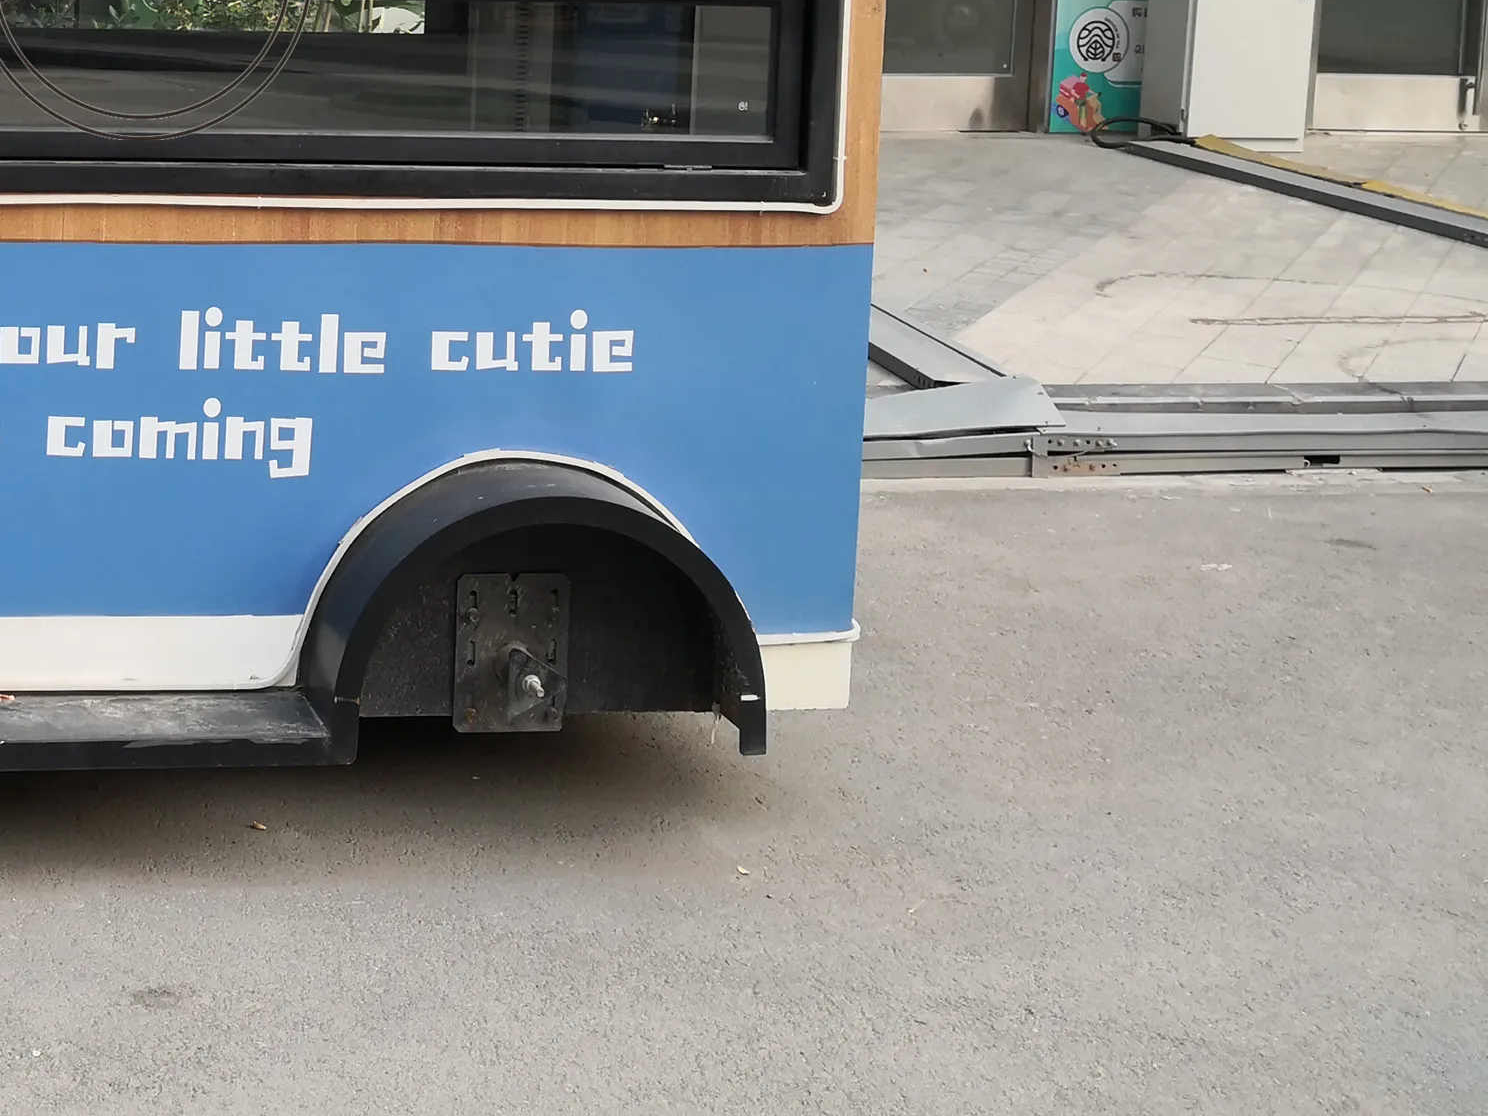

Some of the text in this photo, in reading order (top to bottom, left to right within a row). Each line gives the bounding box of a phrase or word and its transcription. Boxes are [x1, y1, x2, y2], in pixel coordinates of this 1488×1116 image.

[178, 306, 388, 375] little
[431, 308, 635, 373] cutie
[46, 397, 314, 480] coming
